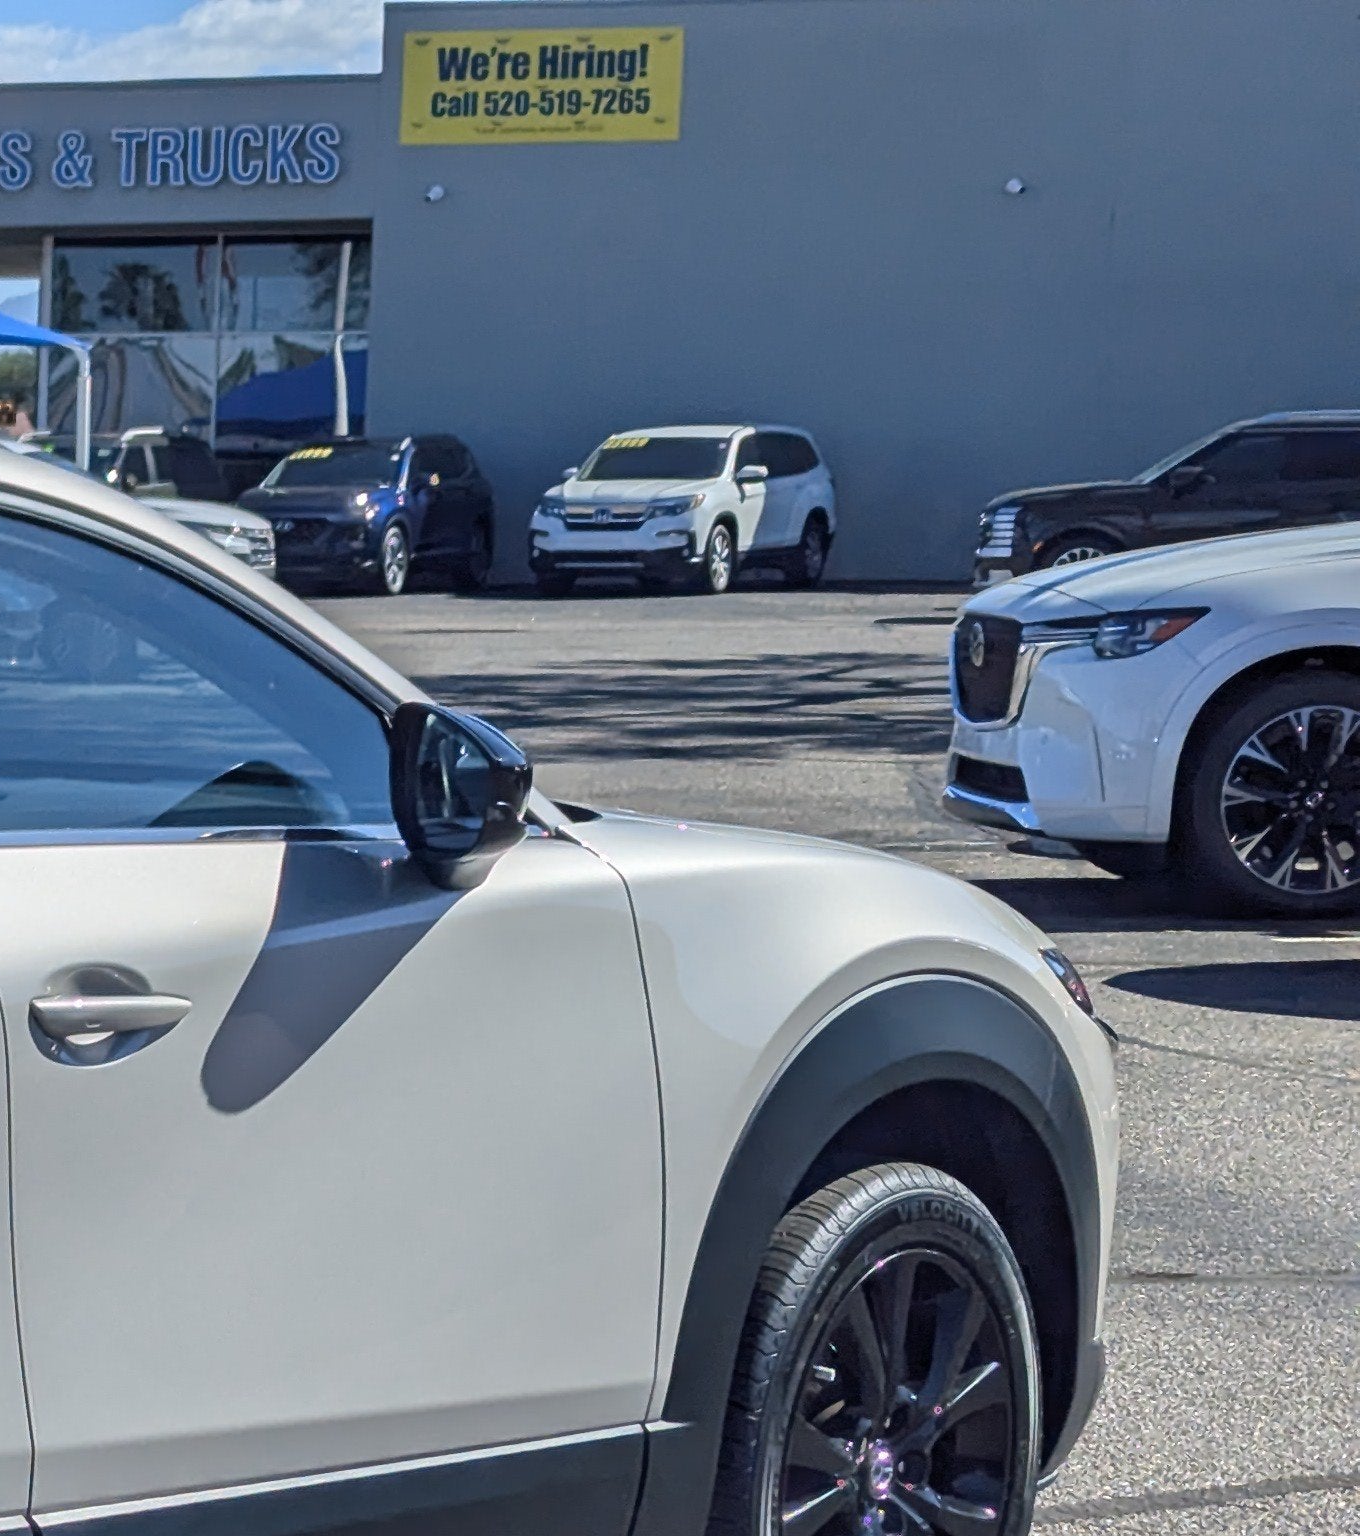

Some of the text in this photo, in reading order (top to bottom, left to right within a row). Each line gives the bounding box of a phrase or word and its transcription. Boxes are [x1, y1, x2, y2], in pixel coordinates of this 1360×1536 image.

[437, 42, 650, 83] We're Hiring!
[431, 87, 651, 118] Call 520-519-7265
[51, 128, 93, 189] &
[110, 122, 340, 188] TRUCKS
